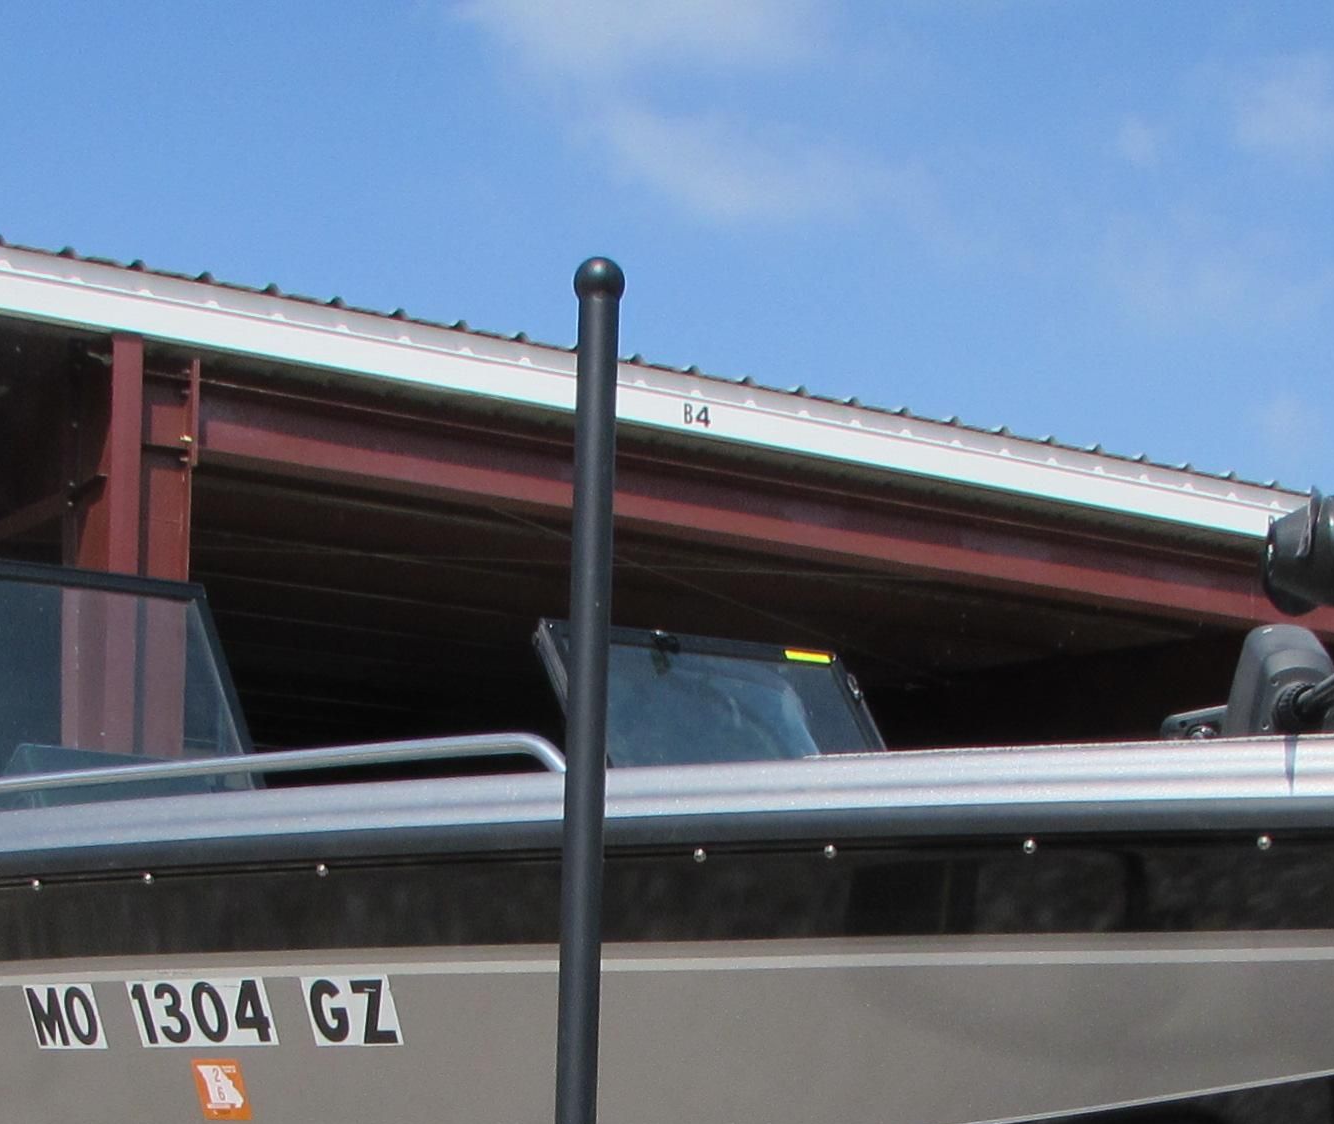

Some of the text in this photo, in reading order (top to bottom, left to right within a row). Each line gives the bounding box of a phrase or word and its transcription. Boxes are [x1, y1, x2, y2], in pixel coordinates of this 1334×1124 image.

[683, 402, 711, 429] B4
[25, 978, 399, 1047] MO 1304 GZ
